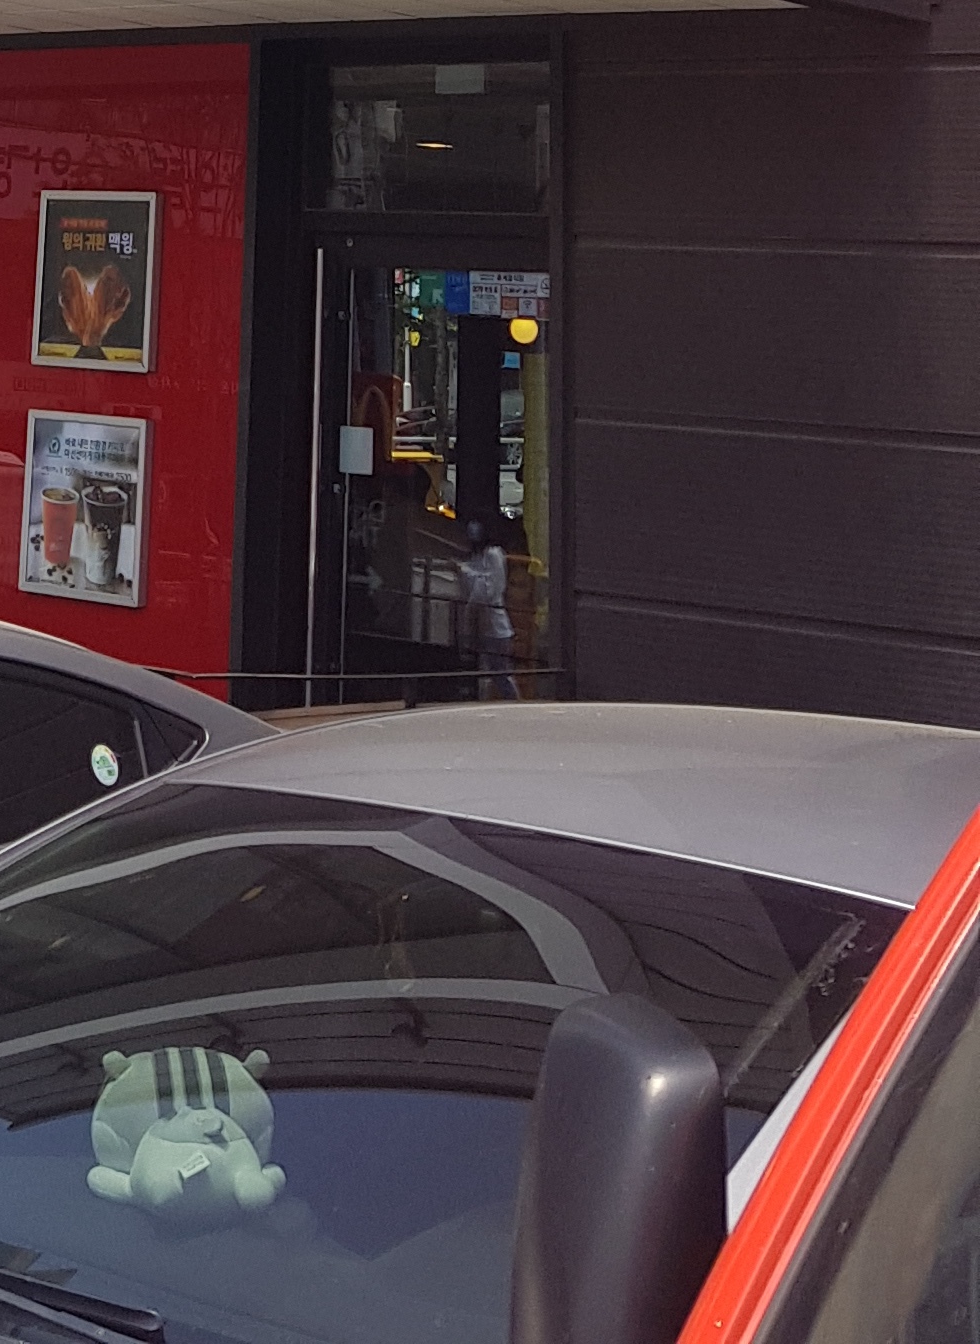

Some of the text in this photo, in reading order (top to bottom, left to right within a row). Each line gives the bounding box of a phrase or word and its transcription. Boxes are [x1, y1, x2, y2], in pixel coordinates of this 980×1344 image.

[62, 232, 134, 254] 윙의 귀환 맥윙
